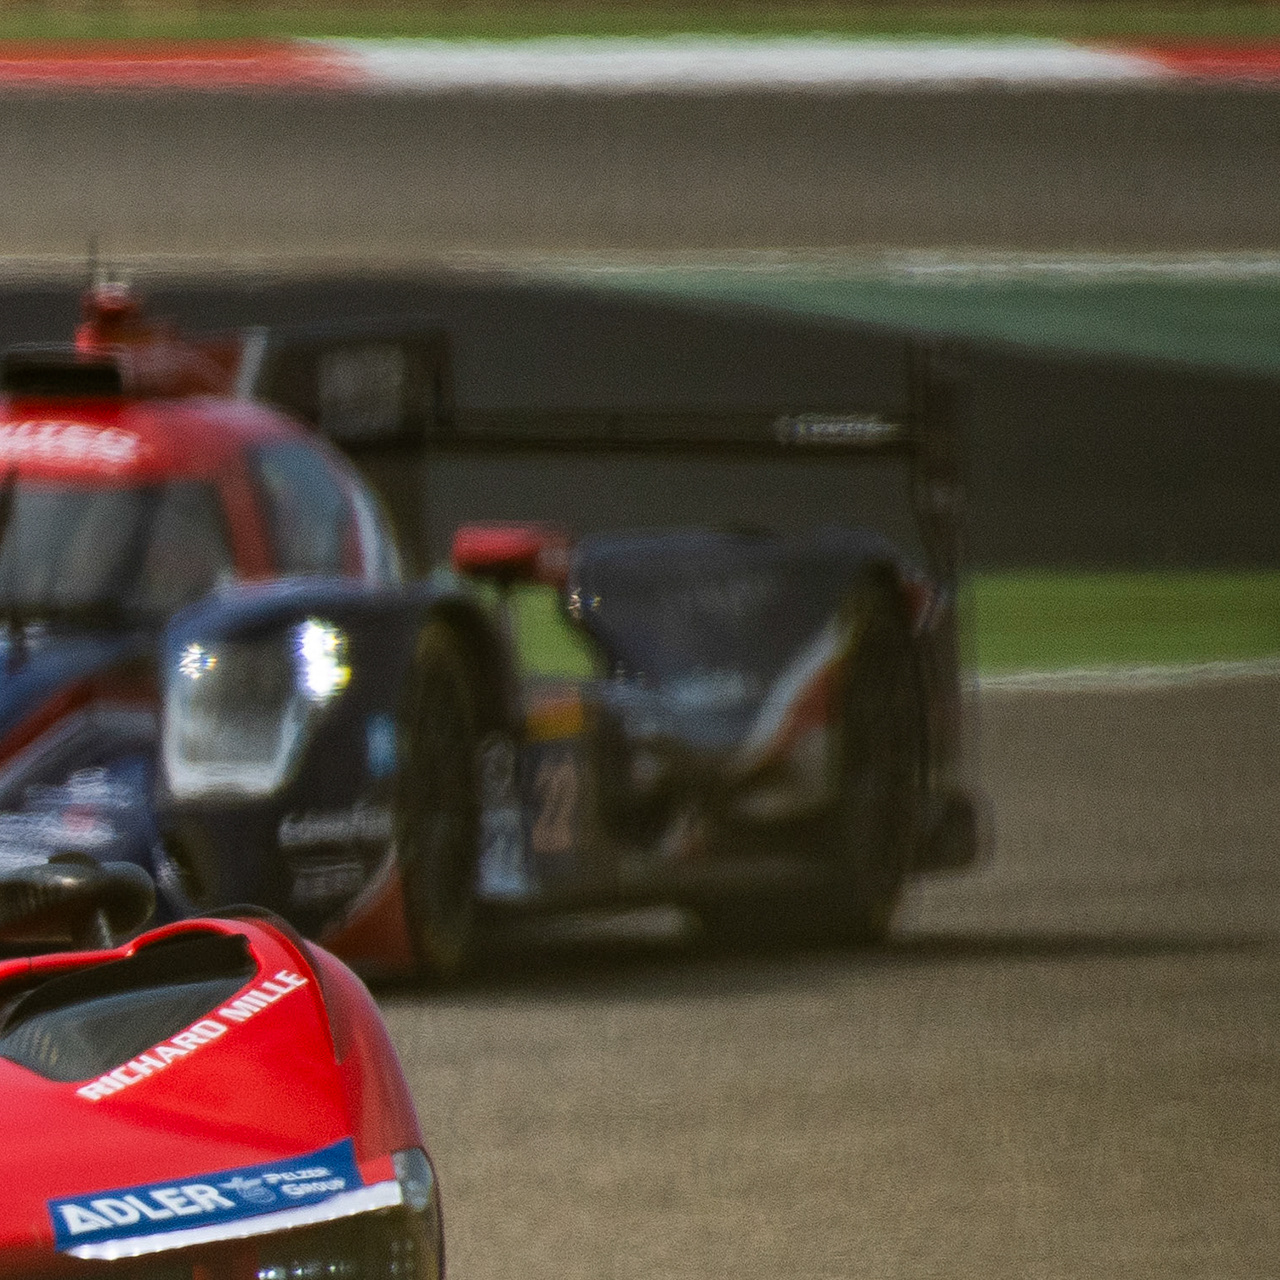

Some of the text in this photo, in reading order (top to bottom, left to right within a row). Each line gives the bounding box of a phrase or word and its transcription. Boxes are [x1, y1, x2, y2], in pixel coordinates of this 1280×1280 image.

[77, 969, 308, 1101] RICHARD MILLE
[59, 1183, 236, 1234] ADLER
